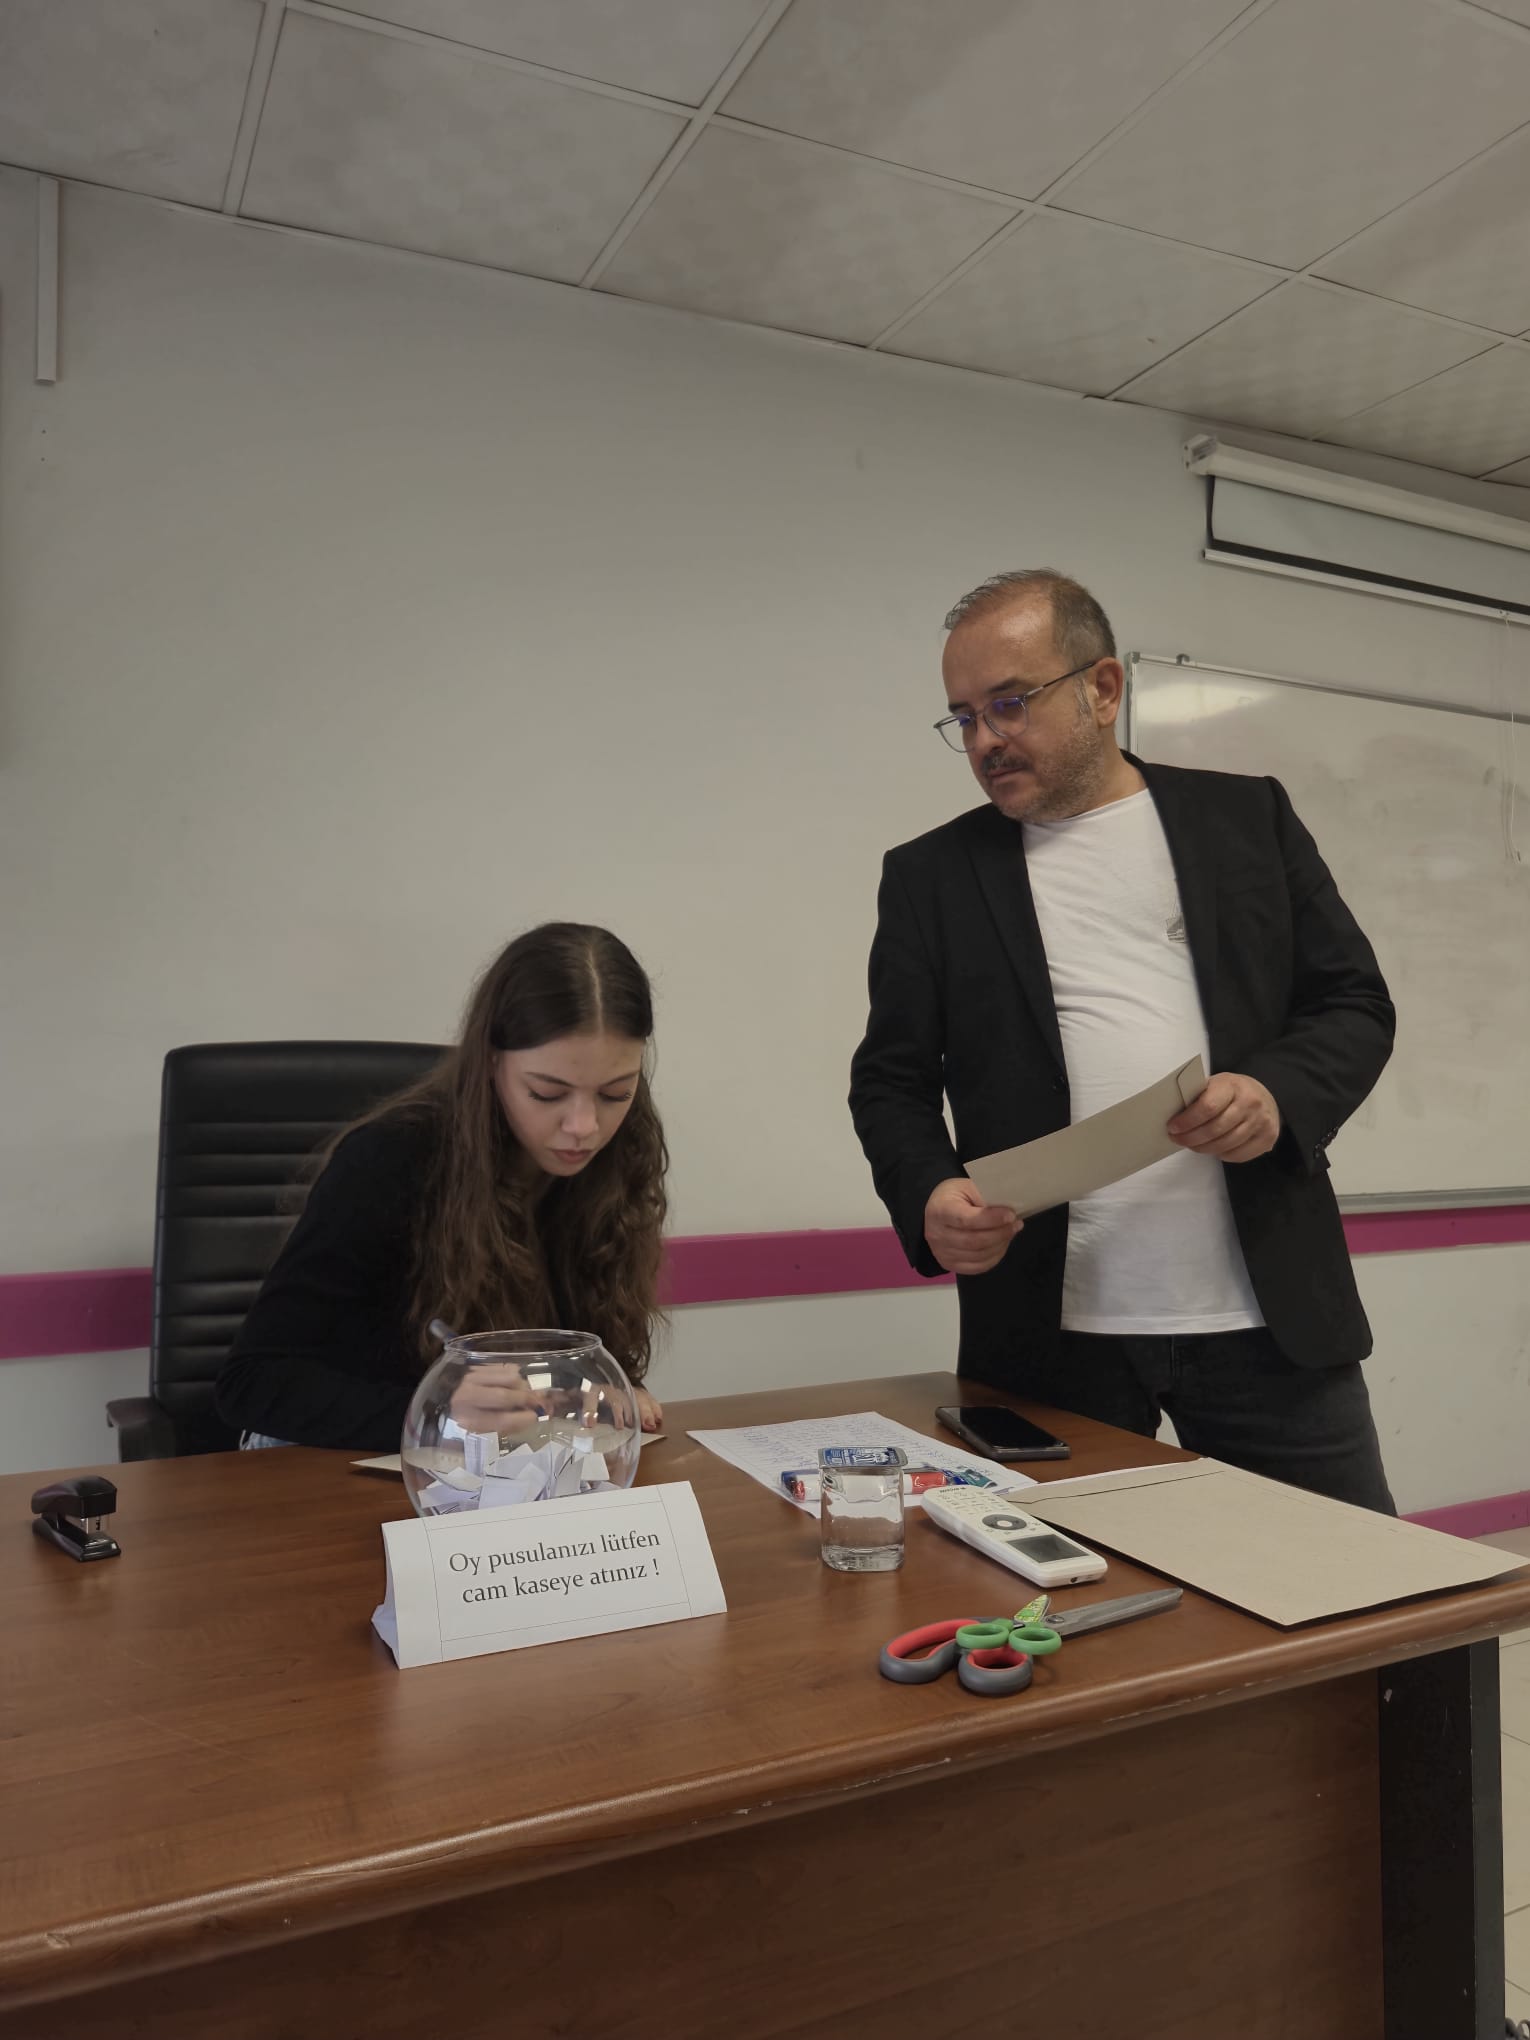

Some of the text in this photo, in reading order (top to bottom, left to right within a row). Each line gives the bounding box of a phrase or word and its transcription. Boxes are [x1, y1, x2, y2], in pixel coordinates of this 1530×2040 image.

[449, 1529, 661, 1576] Oy pusulanızı lütfen
[461, 1557, 660, 1604] cam kaseye atınız !
